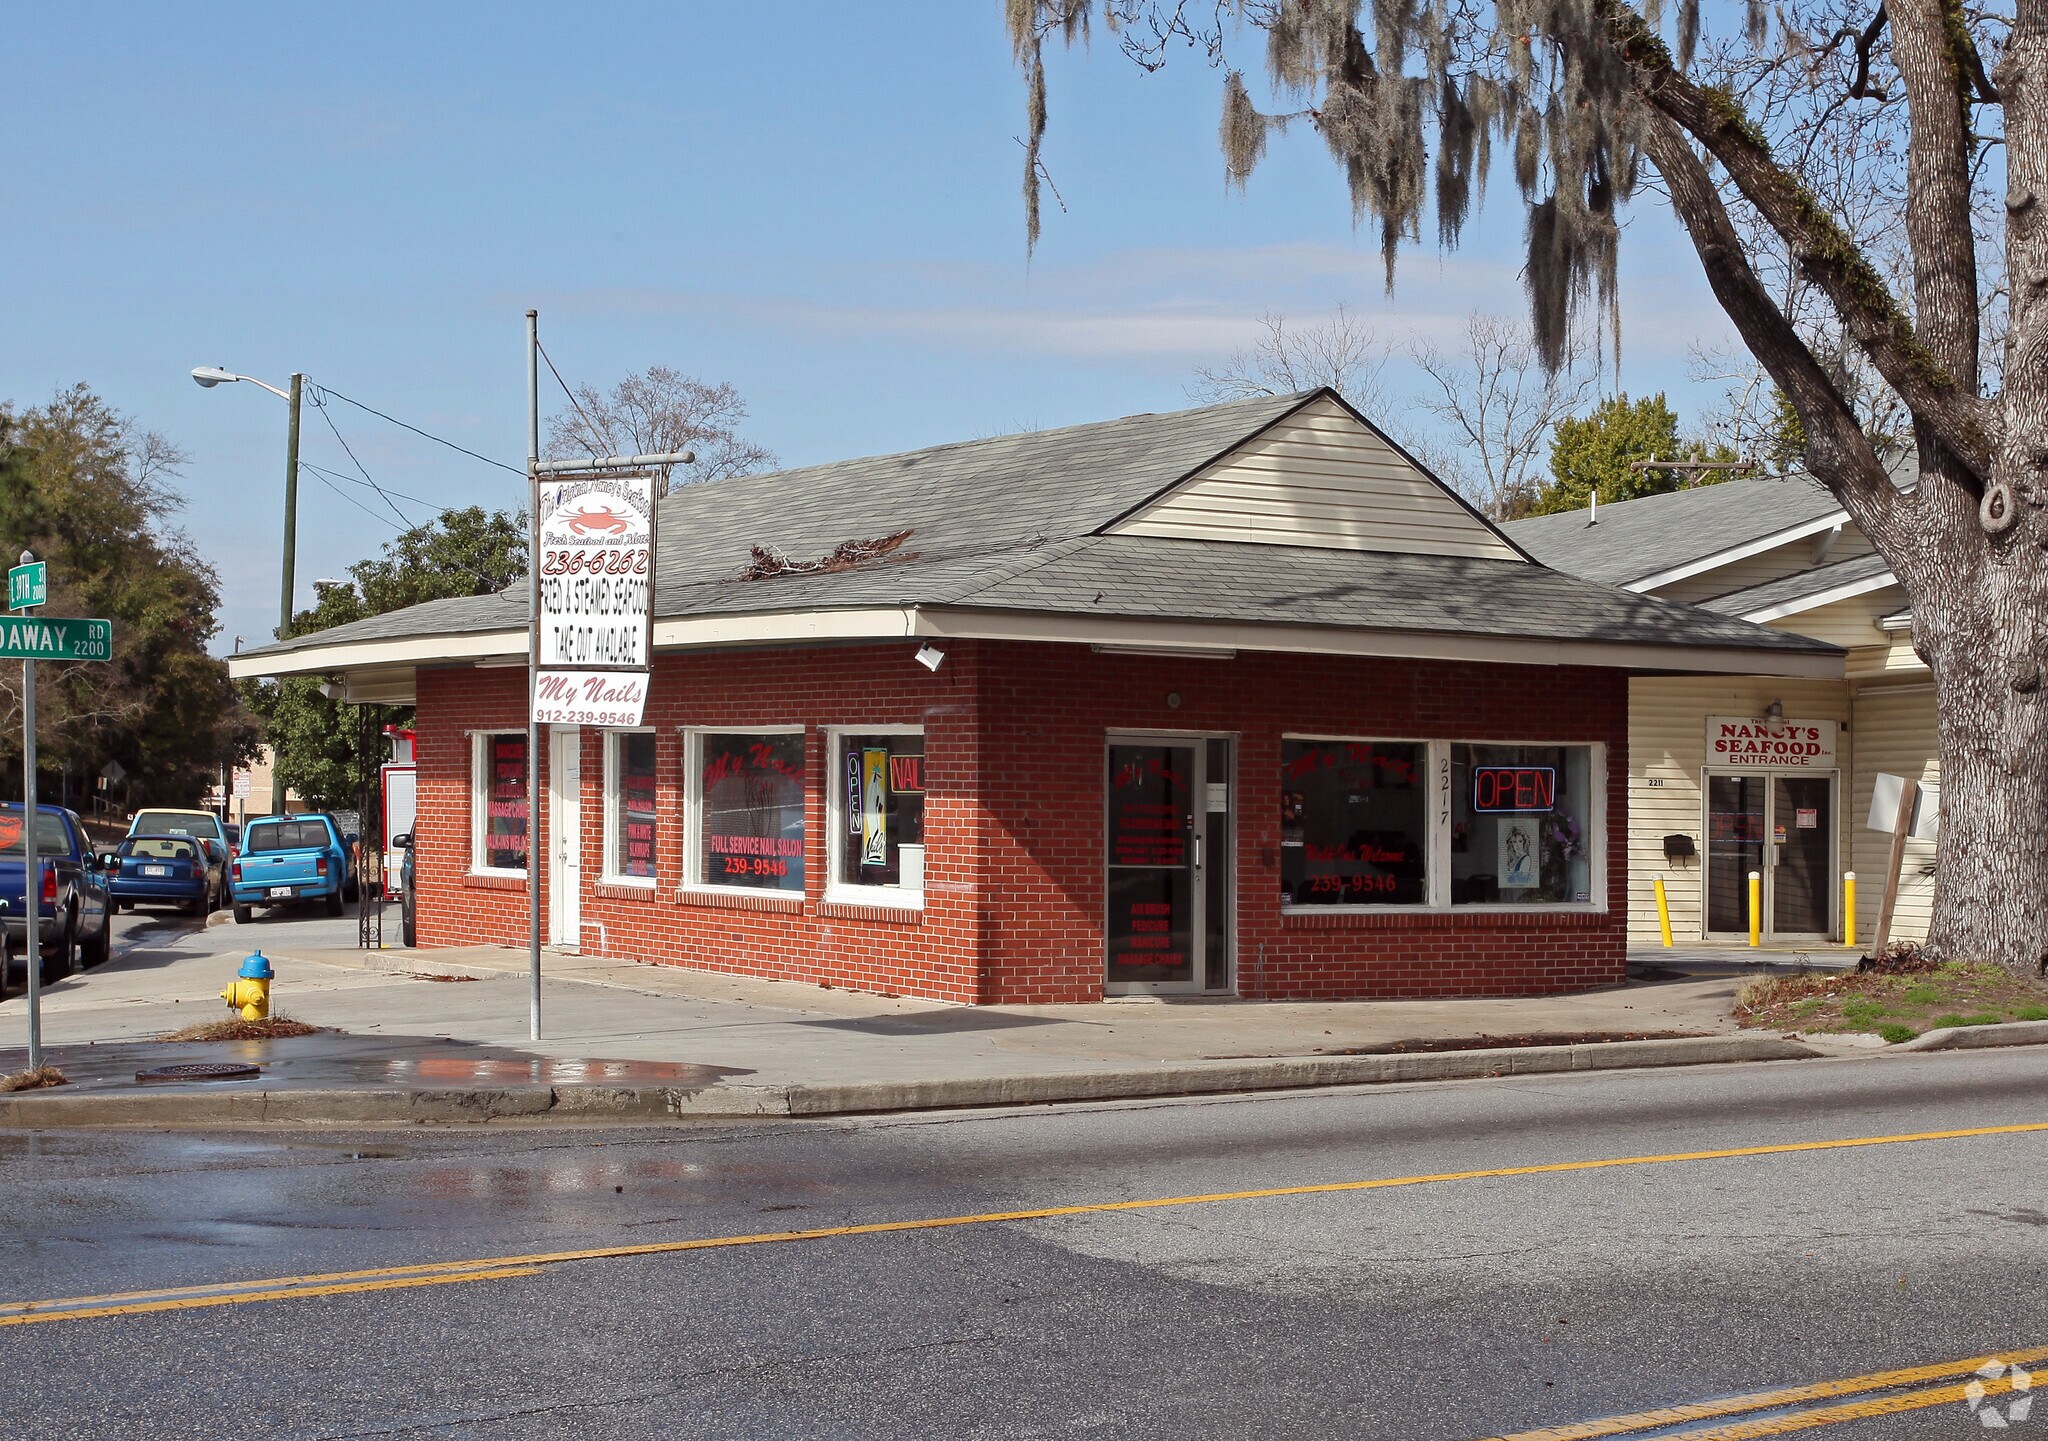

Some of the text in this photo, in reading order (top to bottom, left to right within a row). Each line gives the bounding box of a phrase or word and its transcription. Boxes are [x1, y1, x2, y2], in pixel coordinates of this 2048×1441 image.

[555, 480, 588, 510] Original
[622, 480, 651, 523] Seafoo
[543, 531, 567, 547] Fresh
[568, 536, 604, 547] Seafood
[605, 535, 623, 546] and
[542, 550, 648, 575] 236-6262
[39, 567, 45, 582] ST
[541, 577, 562, 615] FRIED
[566, 578, 572, 615] &
[575, 577, 610, 615] STEAMED
[89, 625, 104, 639] RD
[74, 641, 104, 656] 2200
[554, 625, 637, 664] TAKE OUT AVAILABLE
[539, 675, 642, 706] My Nails
[536, 709, 636, 725] 912-239-9546
[1715, 740, 1820, 756] SEAFOOD
[1729, 754, 1809, 765] ENTRANCE
[849, 757, 861, 829] OPEN
[1441, 758, 1450, 825] 2217
[1477, 770, 1552, 807] OPEN
[711, 835, 802, 857] FULL SERVICE NAIL SALON
[724, 857, 788, 876] 239-9546
[1311, 874, 1396, 891] 239-9546
[1131, 919, 1169, 932] PEDICURE
